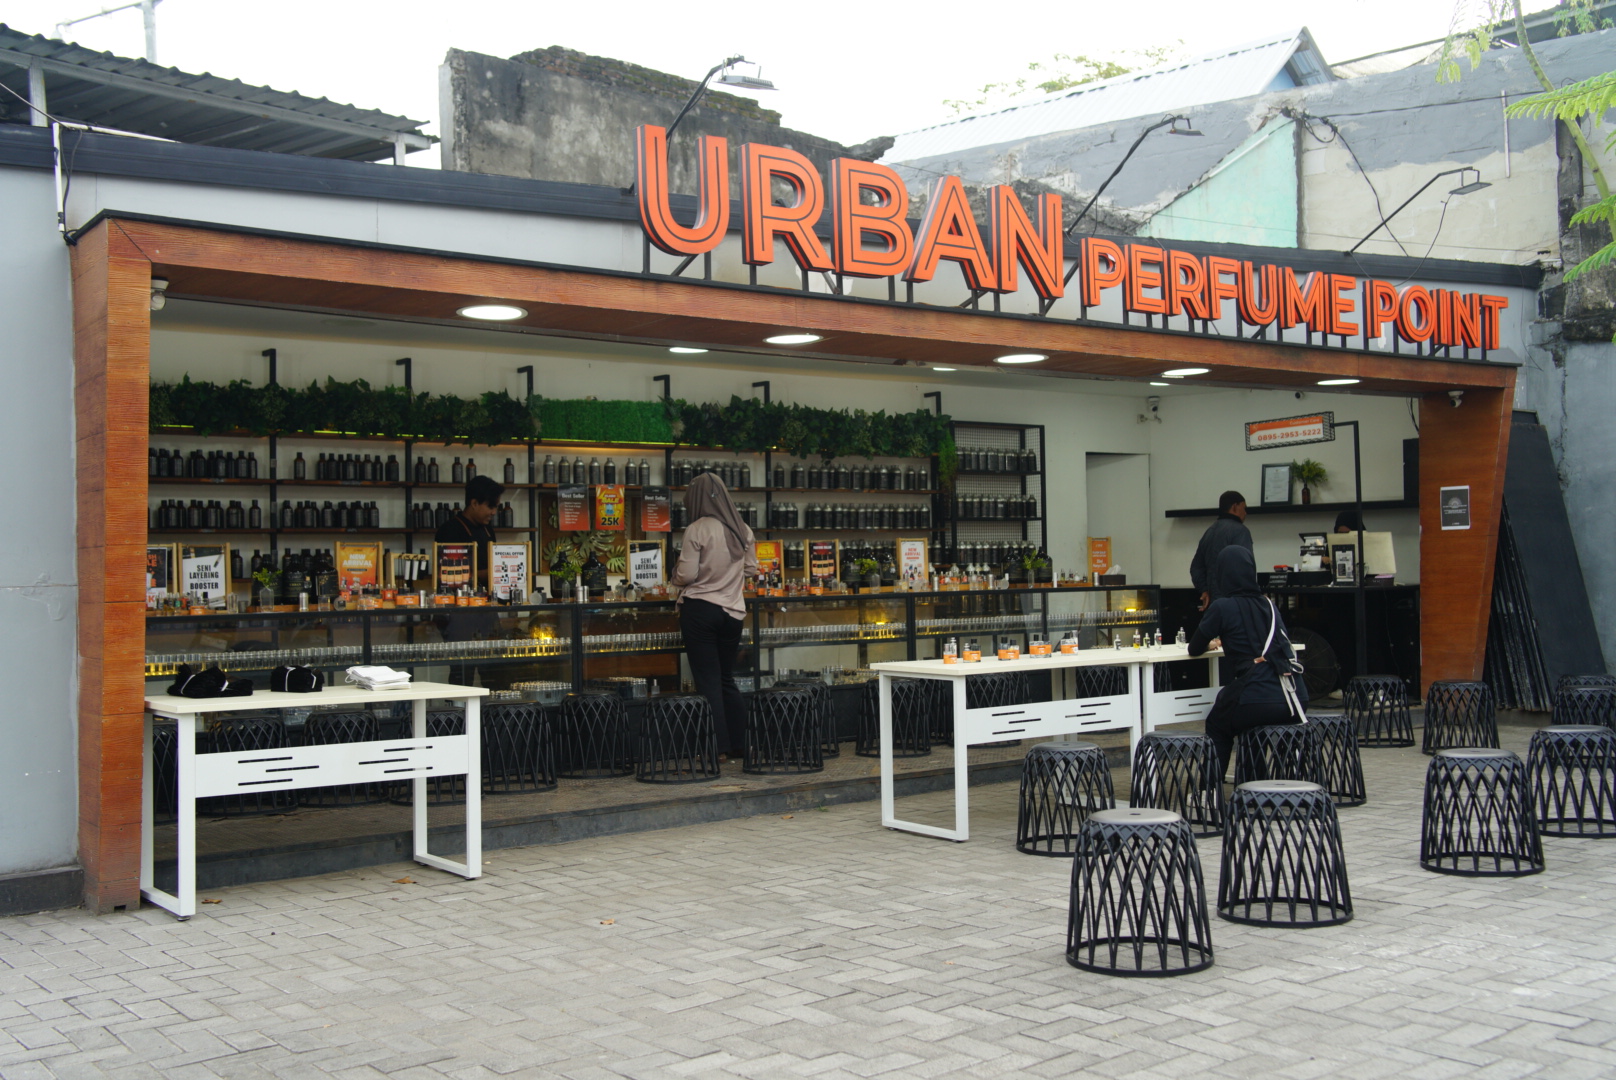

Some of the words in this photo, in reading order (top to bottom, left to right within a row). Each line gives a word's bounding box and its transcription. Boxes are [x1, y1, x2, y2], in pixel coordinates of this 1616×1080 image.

[634, 125, 1064, 299] URBAN
[1080, 237, 1359, 337] PERFUME
[1362, 279, 1508, 350] POINT
[1257, 428, 1321, 441] 0895-2953-5222
[601, 517, 619, 525] 25K
